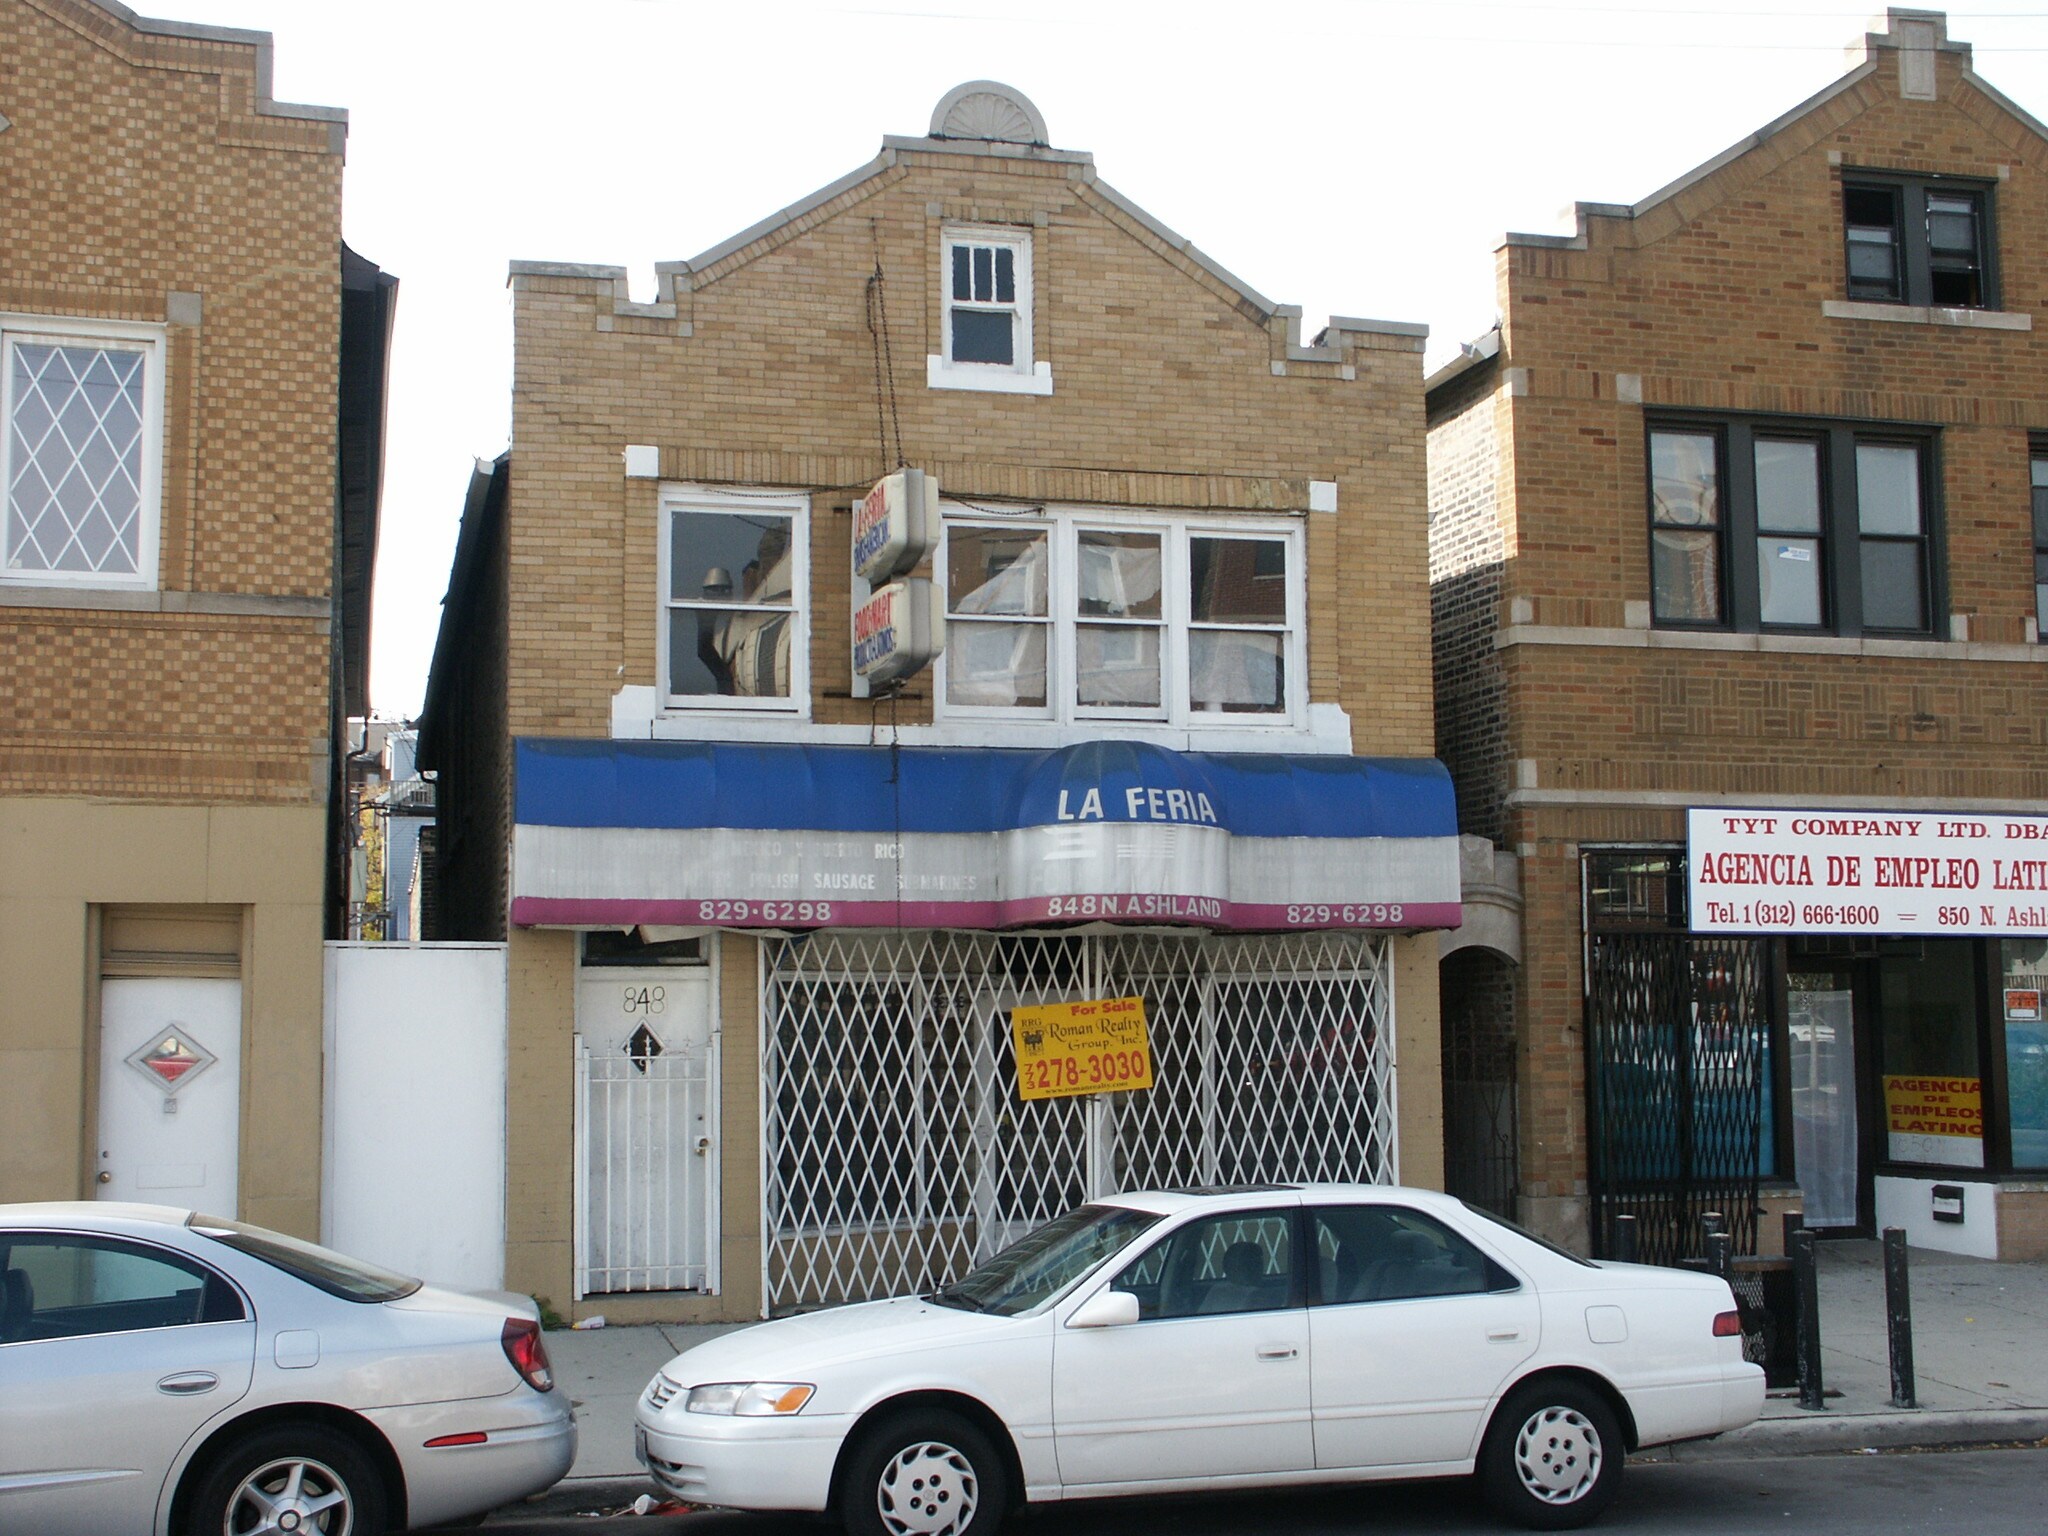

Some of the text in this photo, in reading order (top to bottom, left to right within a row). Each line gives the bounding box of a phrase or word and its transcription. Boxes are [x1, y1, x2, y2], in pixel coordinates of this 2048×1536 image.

[1057, 787, 1217, 822] LA FERIA
[1723, 818, 1778, 835] TYT
[1791, 819, 1922, 837] COMPANY
[1937, 822, 1991, 839] LTD.
[874, 843, 905, 859] RICO
[1700, 852, 1813, 886] AGENCIA
[1826, 855, 1861, 887] DE
[1874, 857, 1980, 889] EMPLEO
[813, 873, 876, 890] SAUSAGE
[1126, 896, 1221, 919] ASHLAND
[1707, 901, 1740, 924] Tel.
[1754, 899, 1796, 927] (312)
[1802, 904, 1879, 925] 666-1600
[1938, 906, 1970, 926] 850
[1980, 906, 1996, 926] N.
[2006, 906, 2048, 927] Ashl
[623, 985, 666, 1015] 848
[1071, 1001, 1137, 1017] For Sale
[1021, 1017, 1042, 1027] RRG
[1046, 1016, 1142, 1042] Roman Realty
[1116, 1034, 1143, 1046] Inc.
[1888, 1079, 1981, 1094] AGENCIA
[1923, 1095, 1951, 1103] DE
[1892, 1120, 1983, 1136] LATINO
